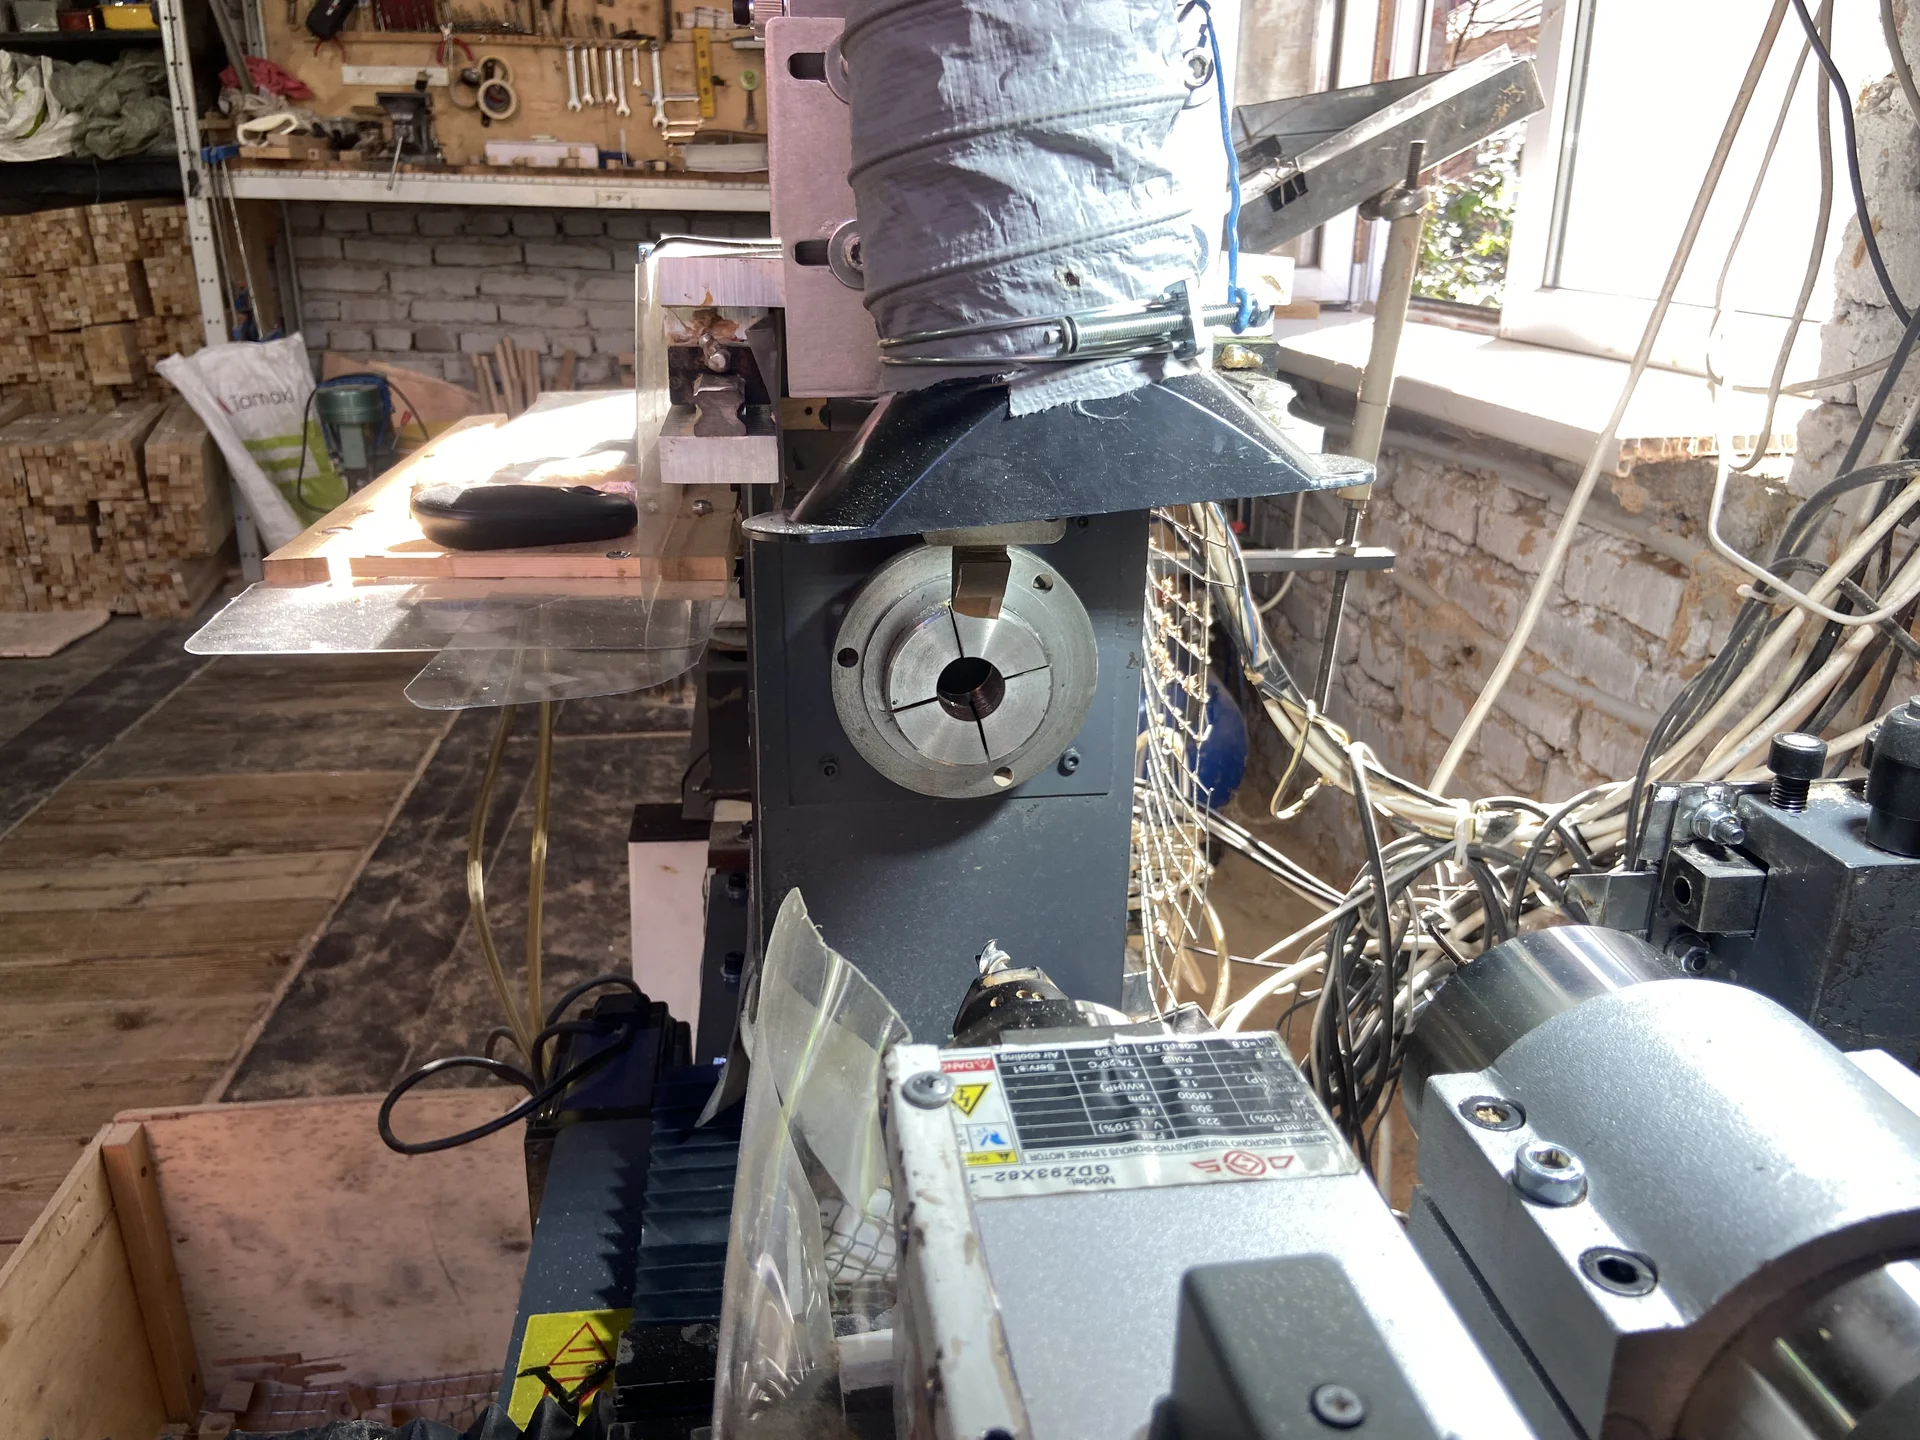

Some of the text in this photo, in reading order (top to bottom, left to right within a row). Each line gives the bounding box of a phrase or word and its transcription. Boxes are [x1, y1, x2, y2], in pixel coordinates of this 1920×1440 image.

[1000, 1051, 1059, 1061] Air cooling
[1129, 1070, 1139, 1078] A
[1100, 1082, 1145, 1092] kW(HP)
[1180, 1079, 1198, 1087] 1.5
[1127, 1094, 1150, 1102] rpm
[1177, 1091, 1213, 1099] 18000
[1139, 1107, 1156, 1115] Hz
[1191, 1104, 1214, 1112] 300
[1305, 1112, 1315, 1120] V
[1197, 1116, 1221, 1125] 220
[1098, 1120, 1164, 1133] V (±10%)
[1273, 1122, 1321, 1132] Spindle
[1231, 1137, 1287, 1147] ASINCRONO
[1029, 1152, 1065, 1161] MOTOR
